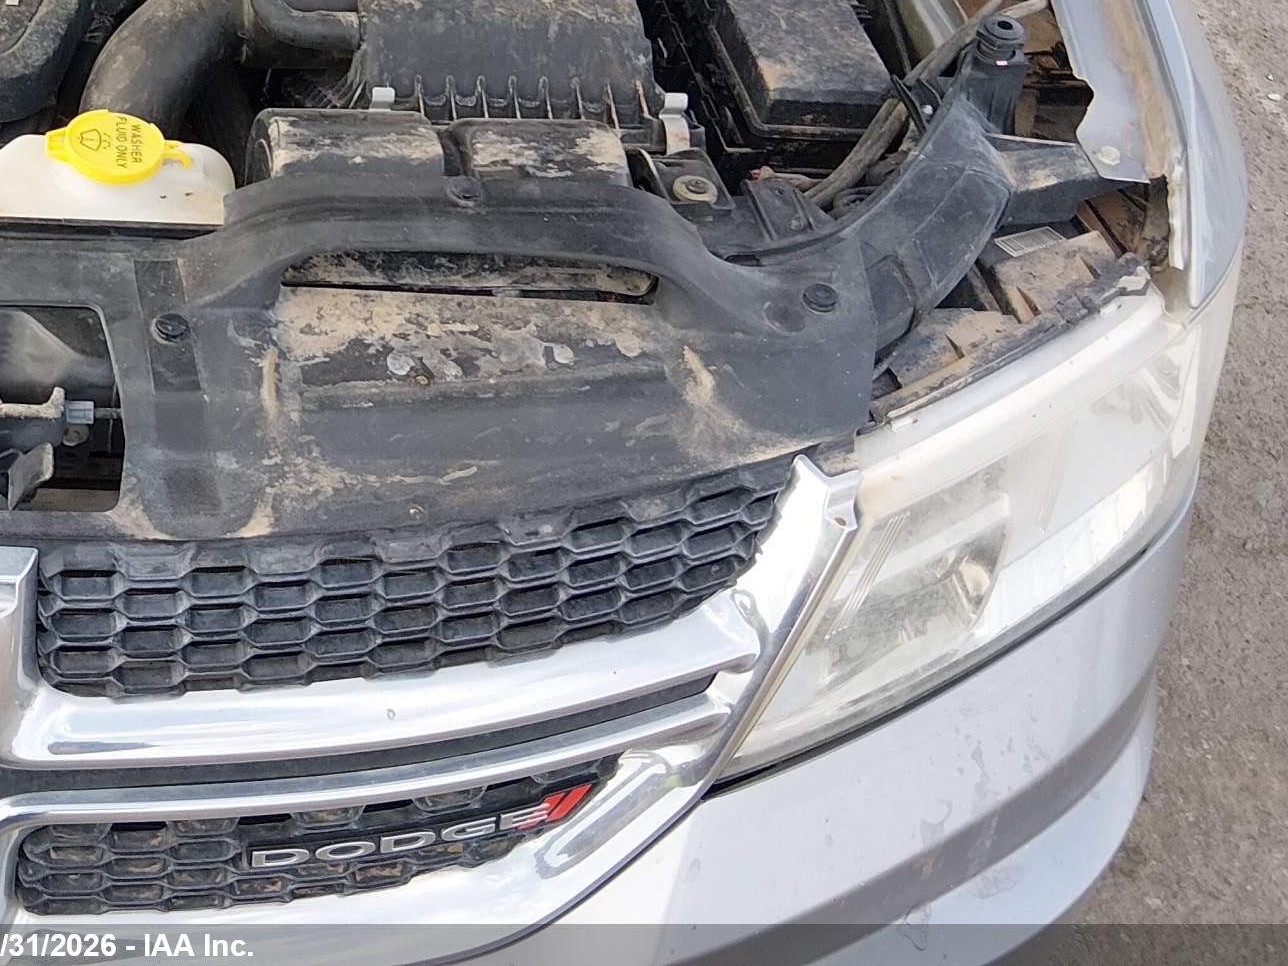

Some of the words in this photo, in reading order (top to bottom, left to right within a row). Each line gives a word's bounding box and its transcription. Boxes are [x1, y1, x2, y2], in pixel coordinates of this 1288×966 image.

[116, 116, 128, 143] FLUID
[130, 123, 143, 164] WASHER
[116, 145, 128, 169] ONLY
[250, 802, 550, 868] DODGE
